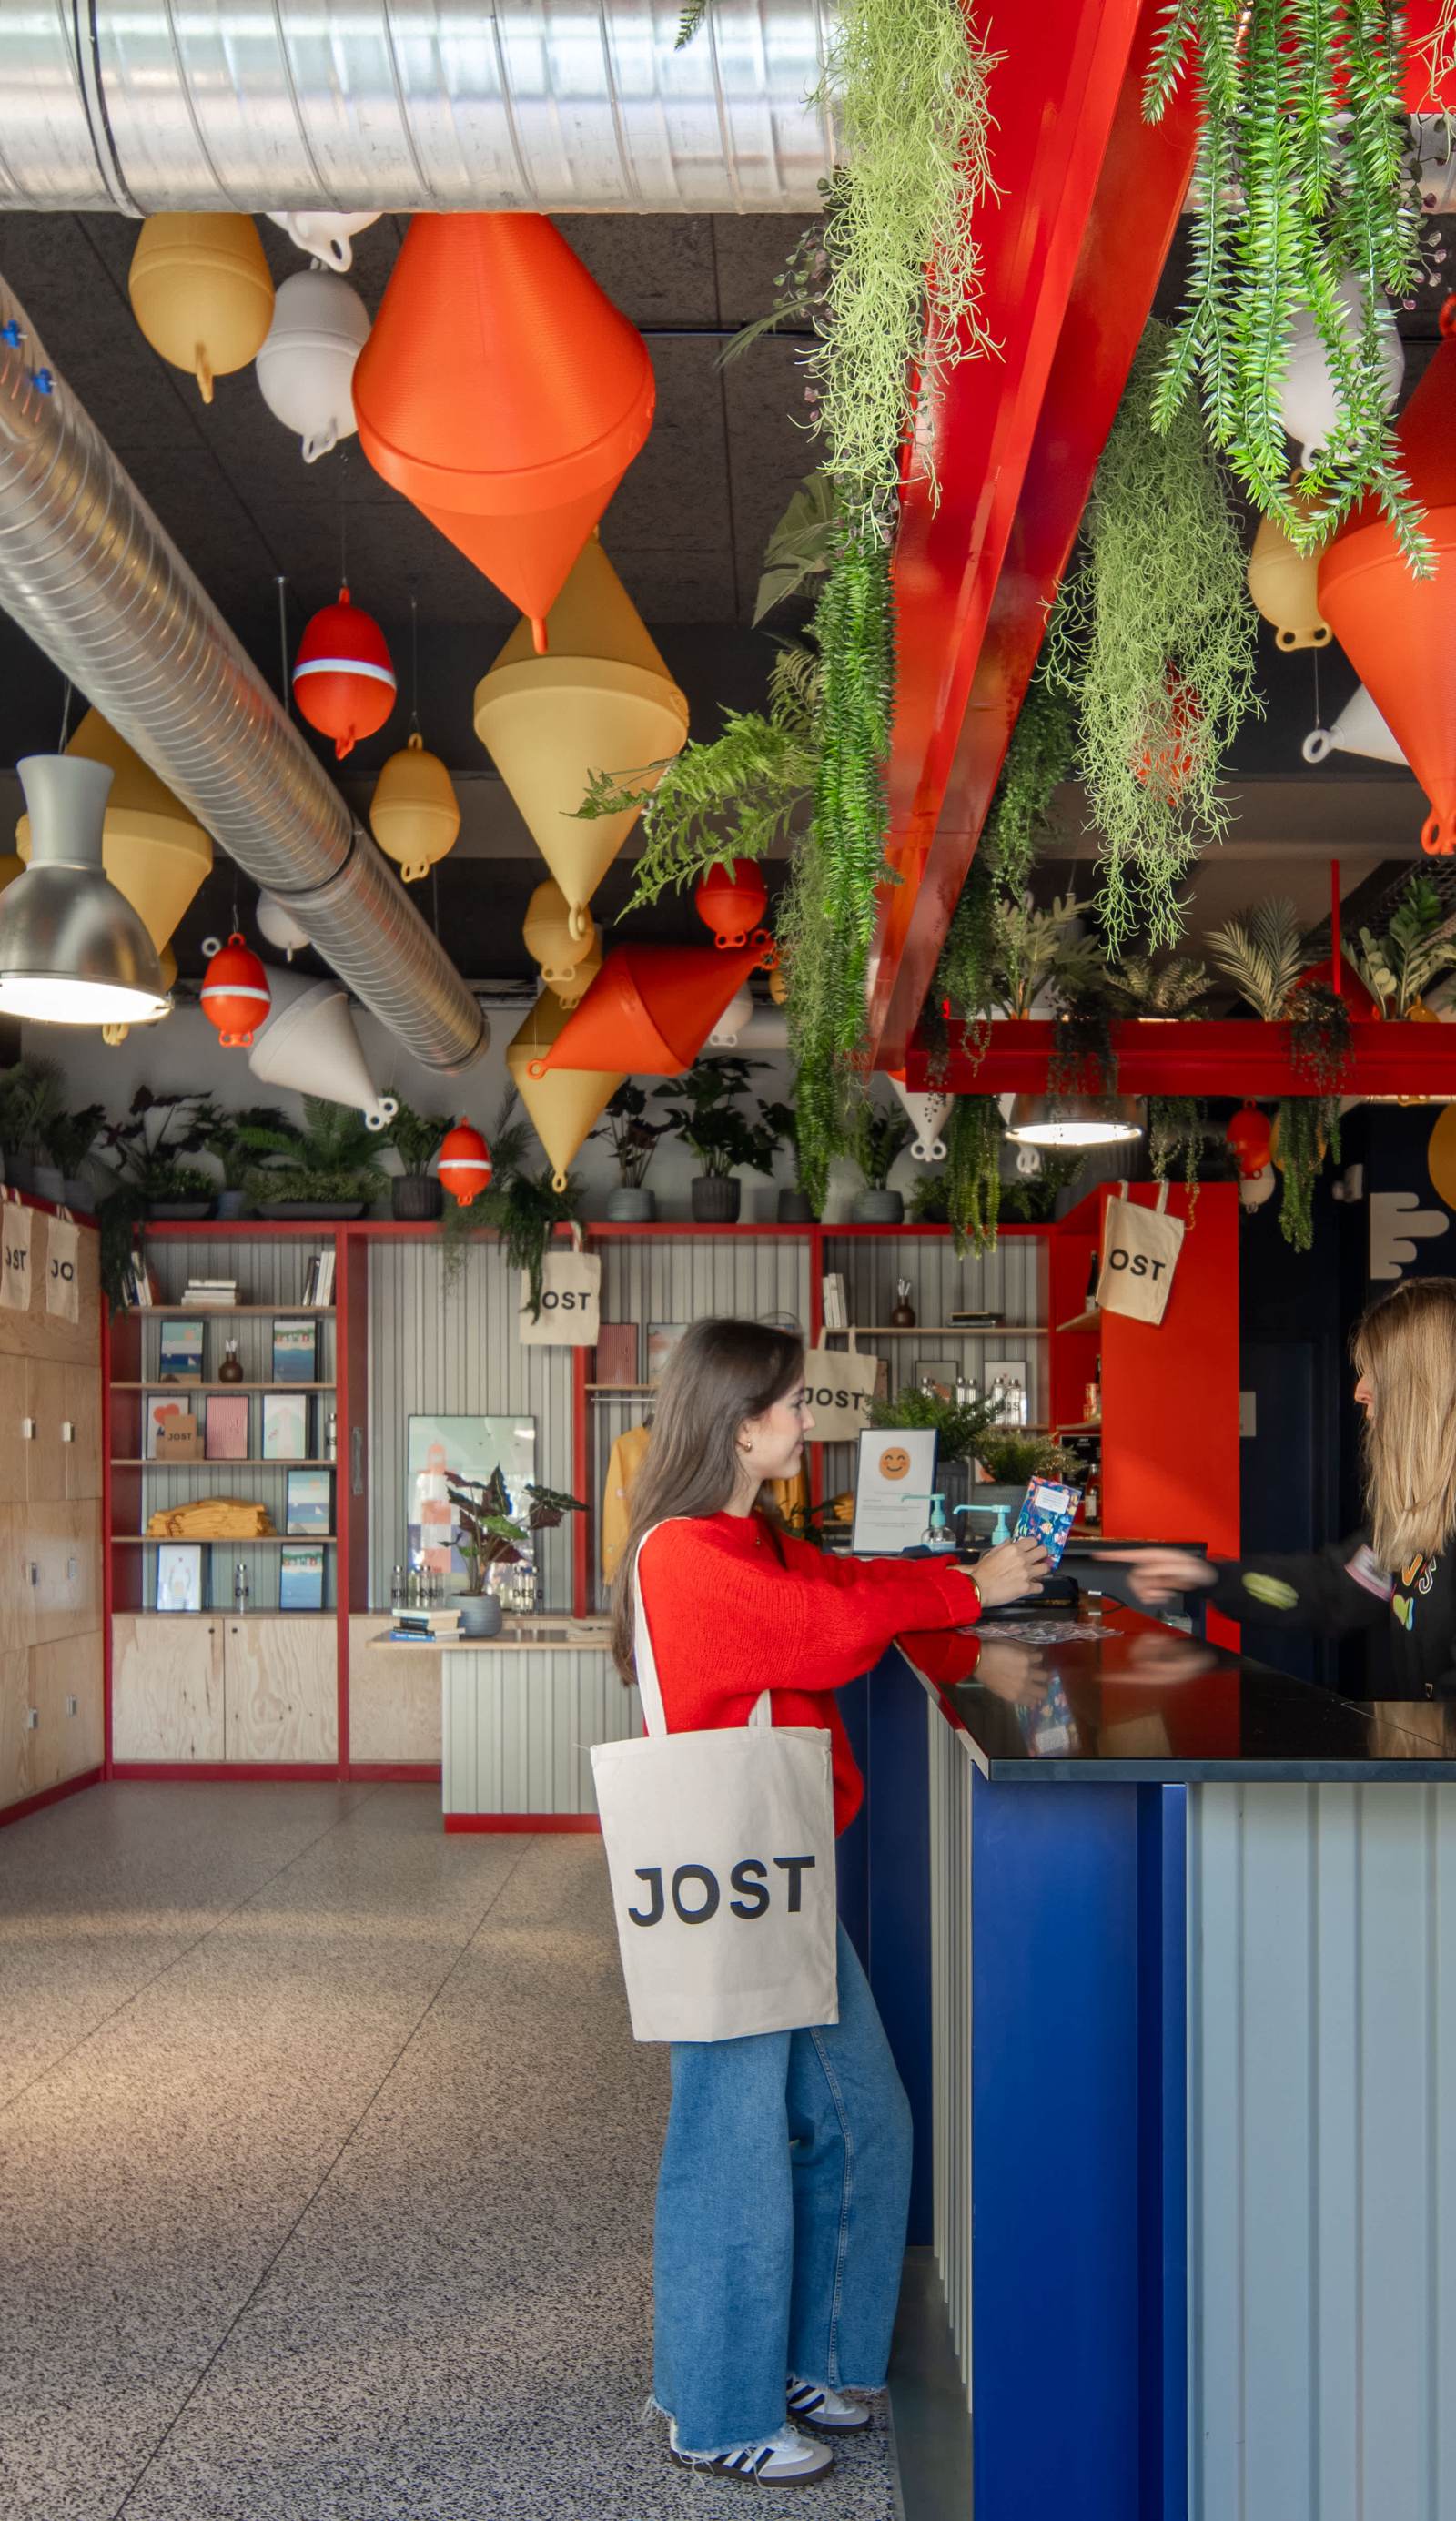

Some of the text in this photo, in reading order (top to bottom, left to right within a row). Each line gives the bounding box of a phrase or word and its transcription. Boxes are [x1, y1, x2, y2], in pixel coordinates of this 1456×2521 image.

[51, 1259, 74, 1281] JO
[1109, 1248, 1166, 1281] OST
[541, 1291, 592, 1311] OST
[167, 1432, 192, 1441] JOST
[627, 1855, 816, 1928] JOST
